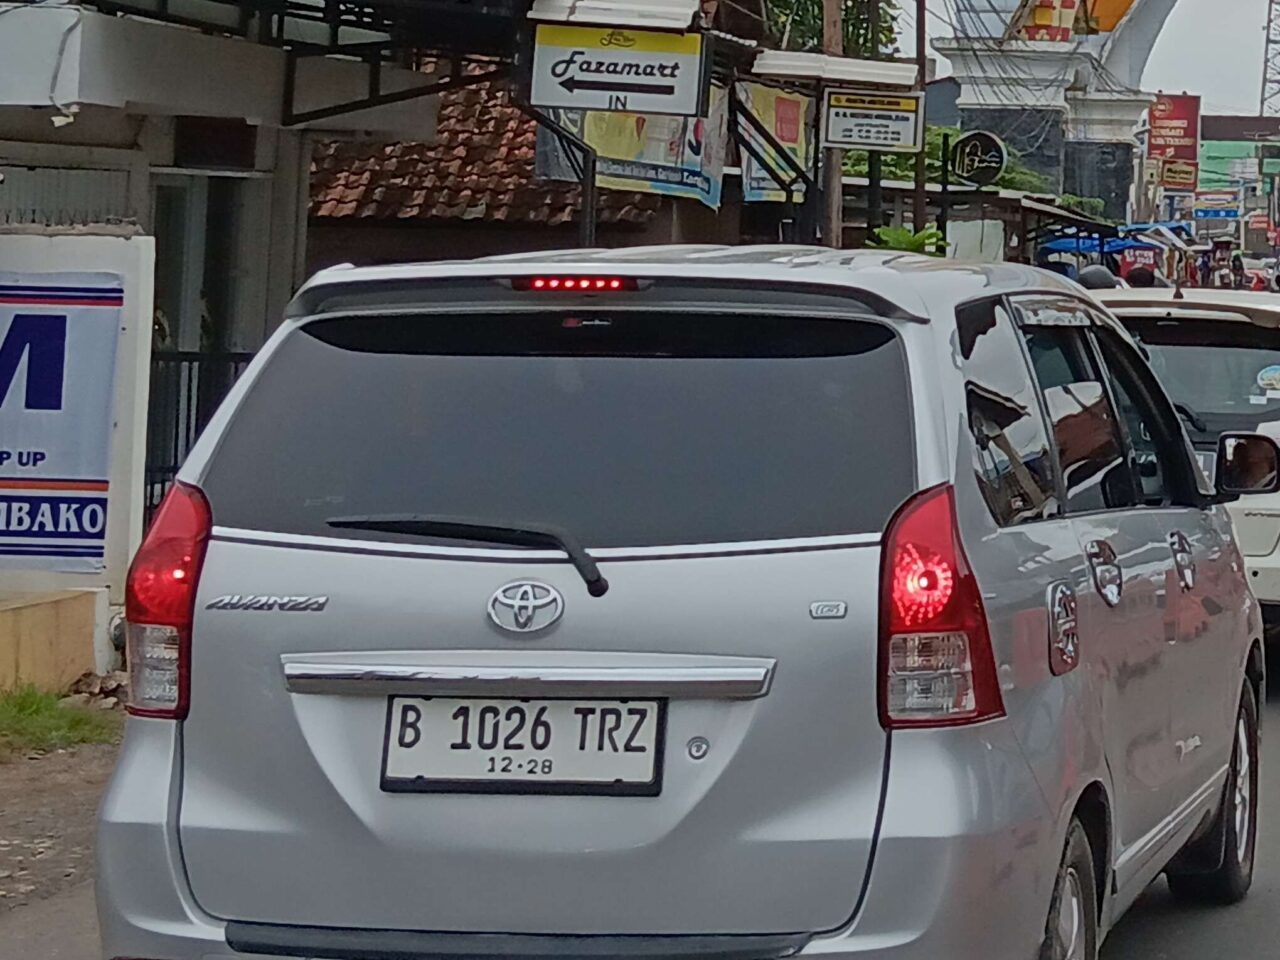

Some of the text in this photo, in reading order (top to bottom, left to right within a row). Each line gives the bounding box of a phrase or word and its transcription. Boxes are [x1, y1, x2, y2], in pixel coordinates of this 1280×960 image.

[551, 51, 680, 78] Fazamart
[608, 95, 628, 110] IN
[18, 451, 46, 467] UP
[205, 595, 329, 611] AVANZA
[398, 705, 648, 752] B 1026 TRZ
